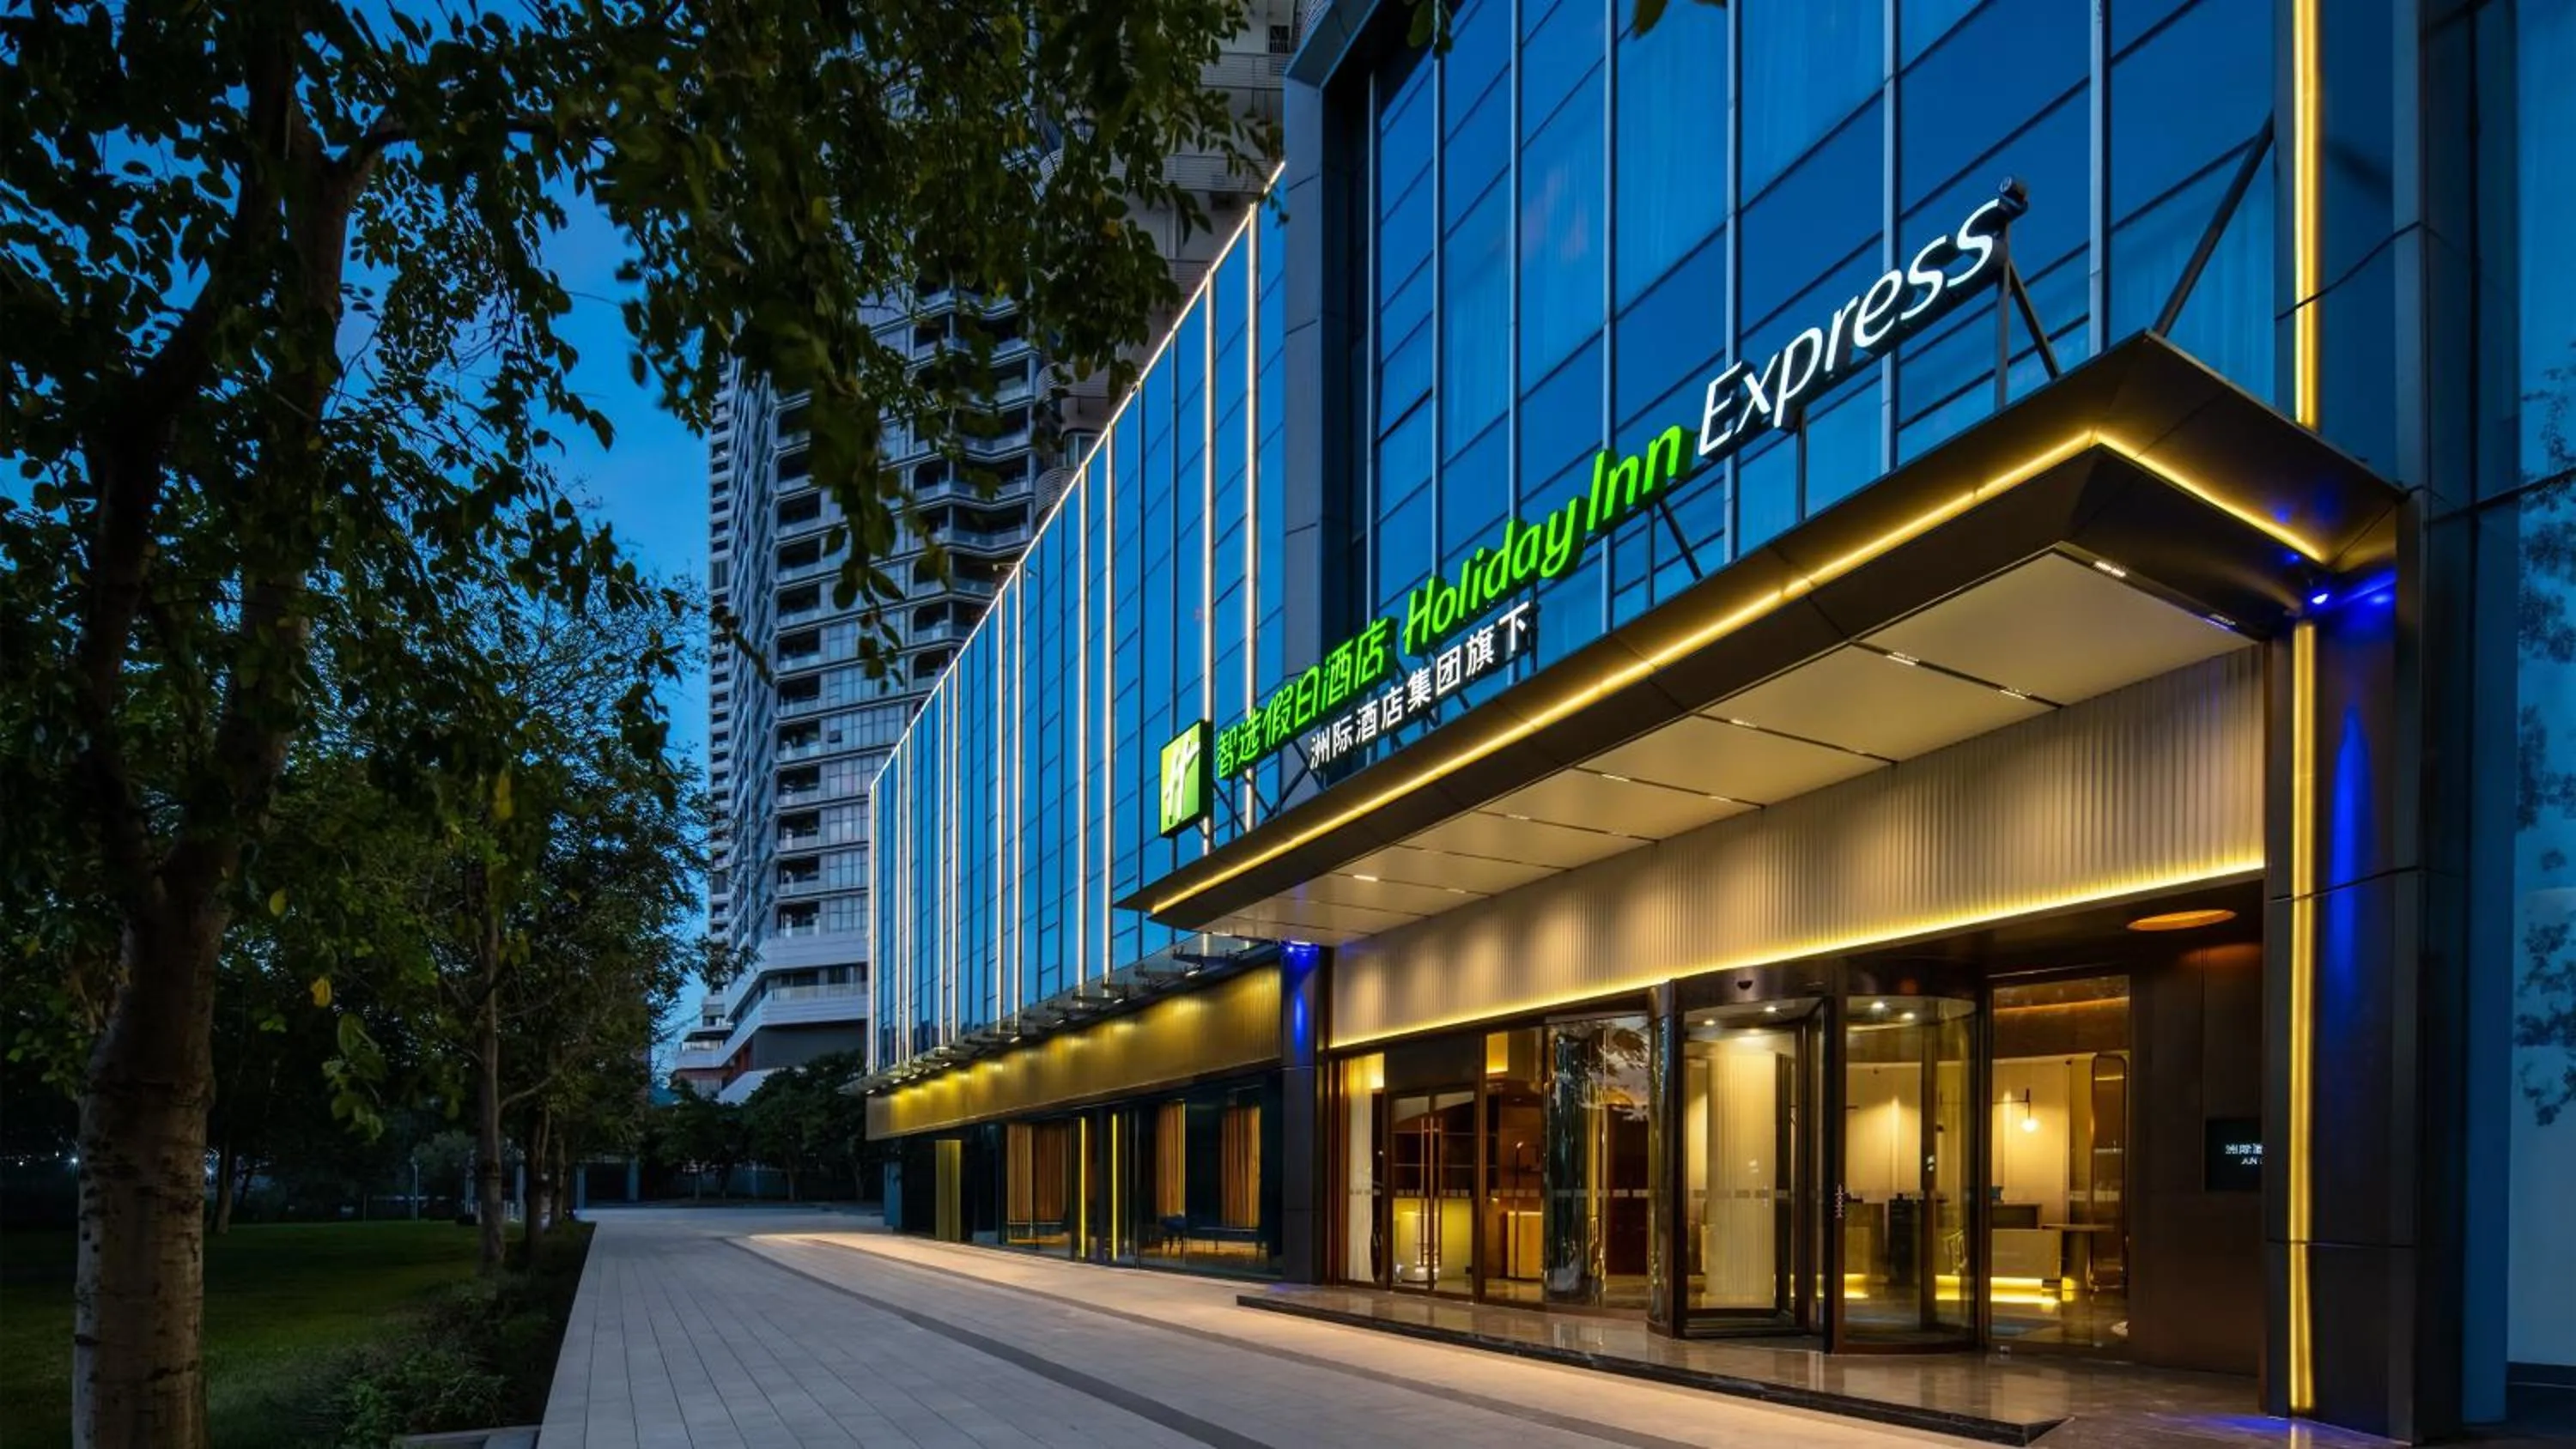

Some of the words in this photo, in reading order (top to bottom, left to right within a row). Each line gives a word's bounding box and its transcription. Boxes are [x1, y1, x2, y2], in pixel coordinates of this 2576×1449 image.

[1402, 497, 1578, 655] Holiday
[1586, 424, 1682, 532] Inn
[1698, 197, 2000, 457] Express
[1217, 617, 1388, 779] 智选假日酒店
[1309, 601, 1529, 770] 洲际酒店集团旗下
